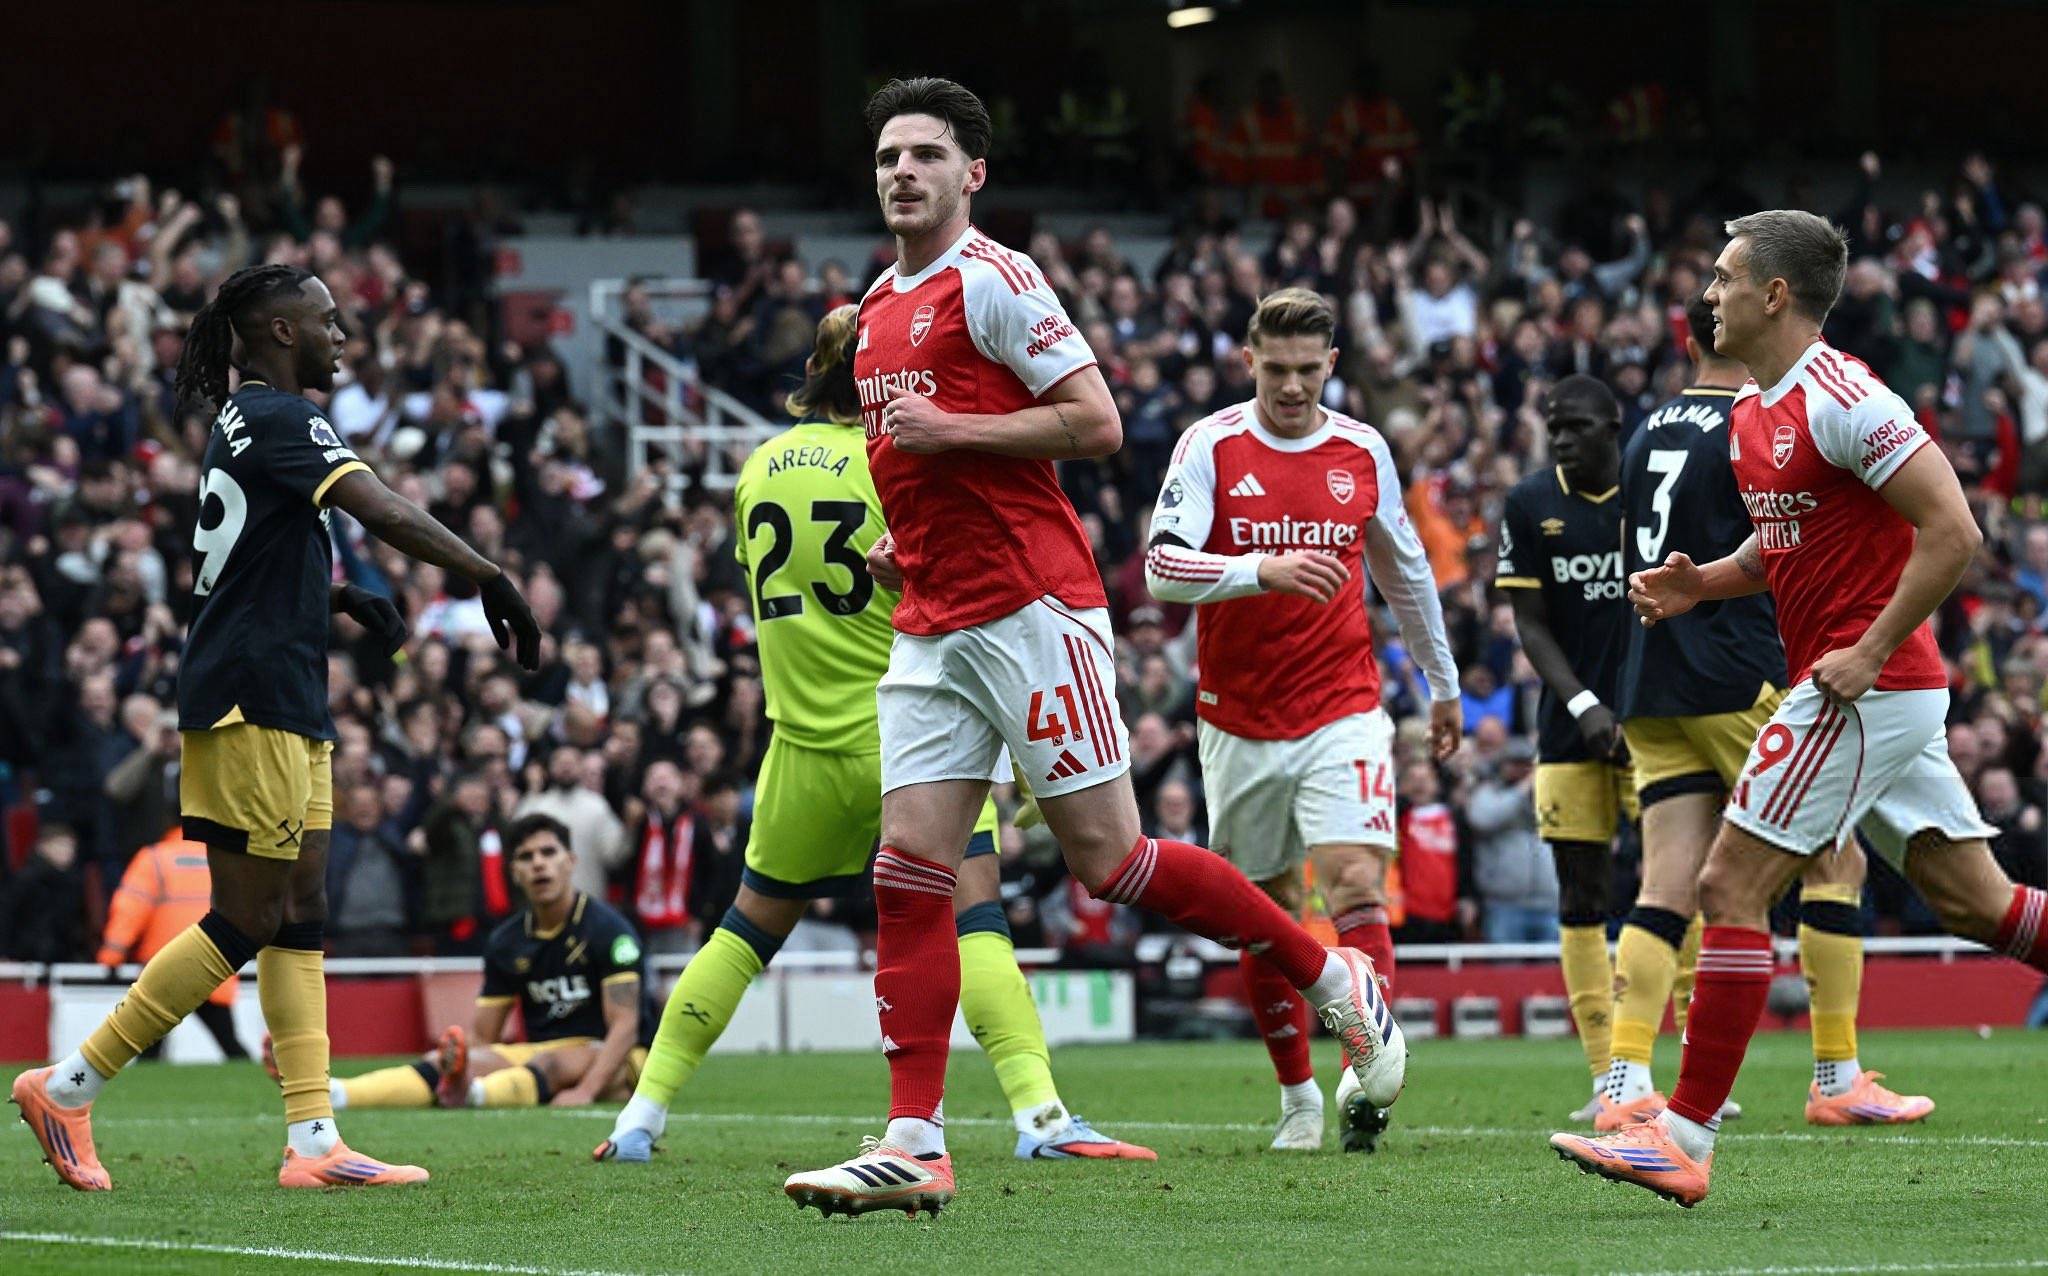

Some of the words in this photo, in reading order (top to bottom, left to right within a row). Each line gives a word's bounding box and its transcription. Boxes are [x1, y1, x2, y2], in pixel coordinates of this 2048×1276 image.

[1026, 324, 1077, 358] RWAND
[854, 366, 937, 407] mirates
[1647, 404, 1725, 434] KILMAN
[1863, 419, 1898, 448] VISIT
[768, 446, 850, 478] AREOLA
[1861, 426, 1918, 470] RWANDA
[1636, 449, 1690, 563] 3
[192, 466, 248, 596] 9
[1229, 514, 1358, 547] Emirates
[748, 500, 874, 621] 23
[1026, 683, 1085, 747] 41
[1748, 722, 1794, 778] 9
[1353, 759, 1394, 808] 14
